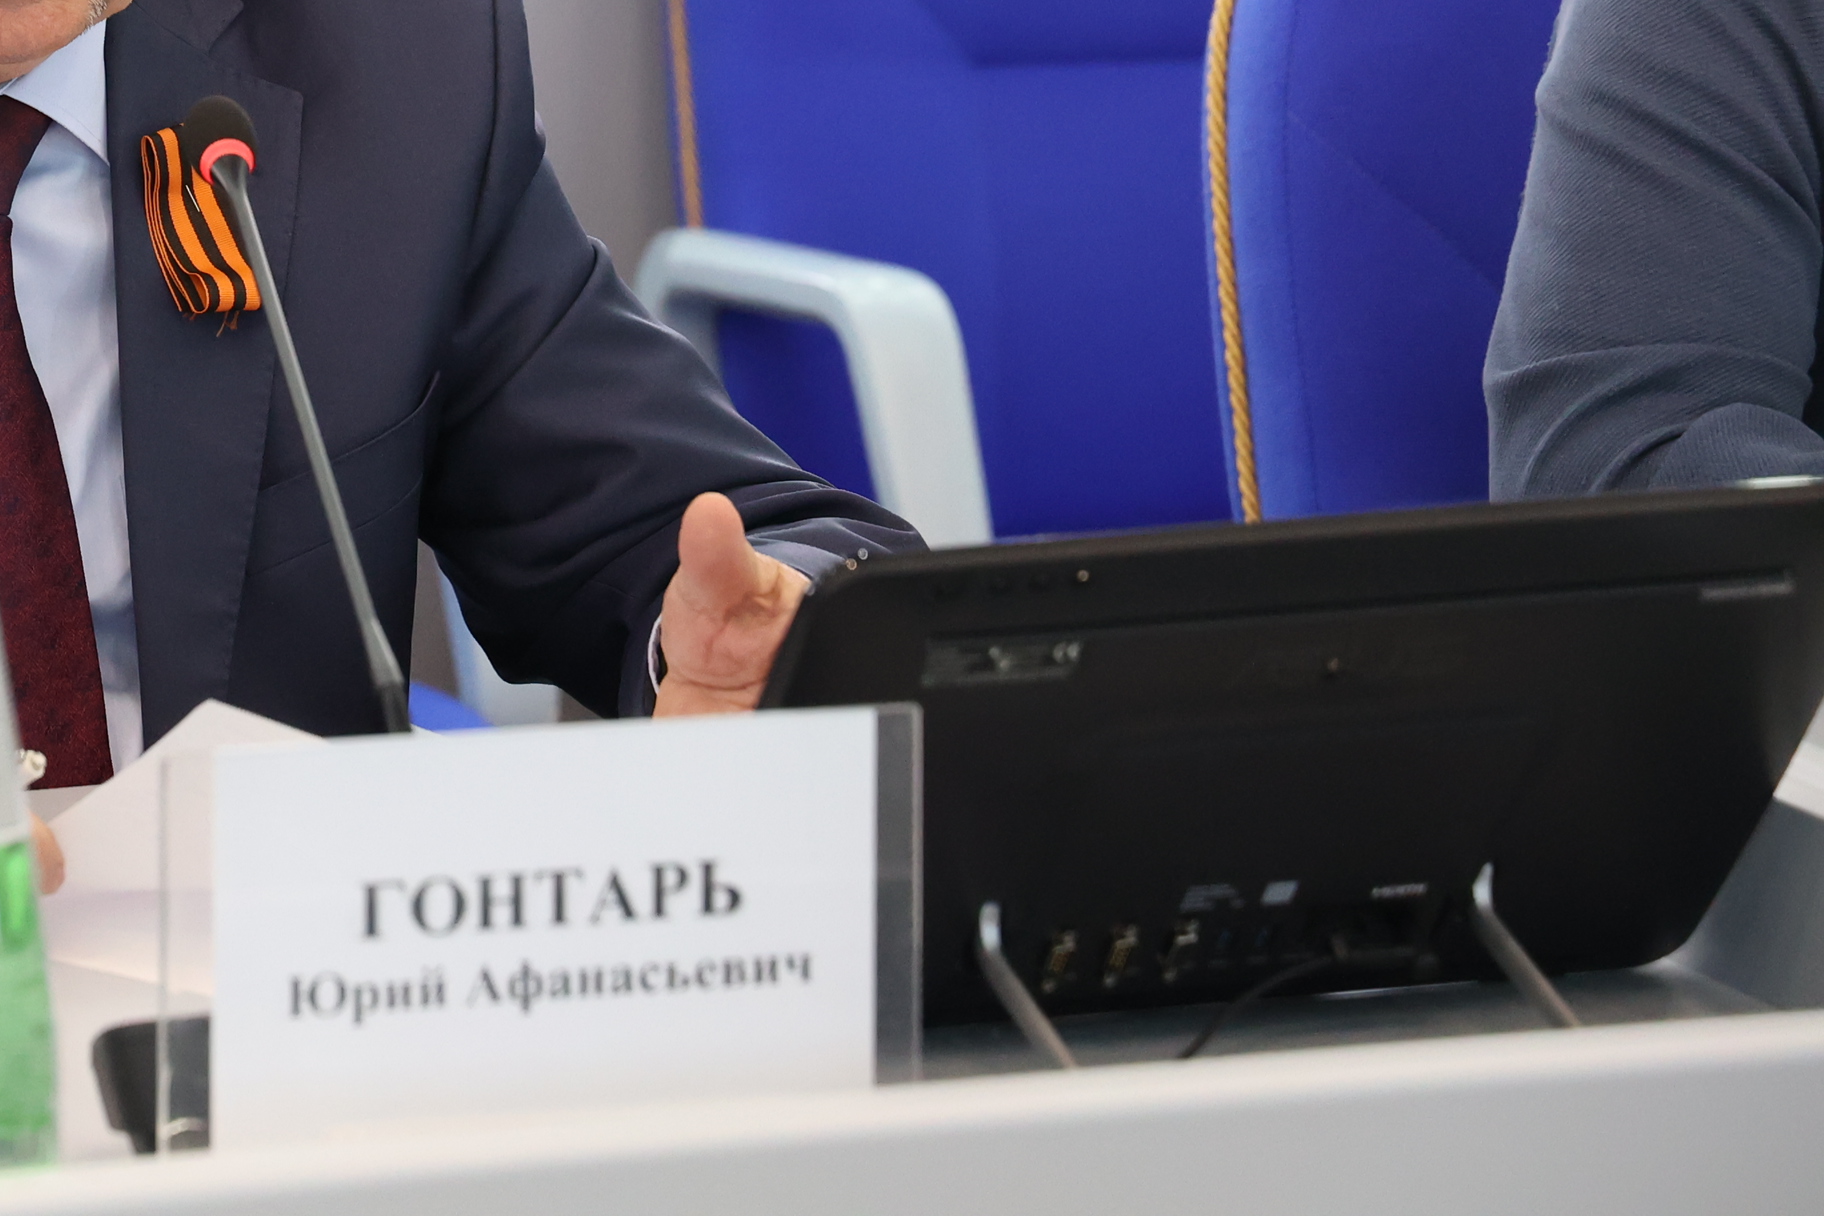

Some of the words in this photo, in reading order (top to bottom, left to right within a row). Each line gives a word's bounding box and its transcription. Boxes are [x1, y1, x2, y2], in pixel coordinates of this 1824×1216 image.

[360, 858, 745, 940] ГОНТАРЬ
[288, 969, 447, 1026] Юрий
[467, 951, 813, 1014] Афанасьевич
